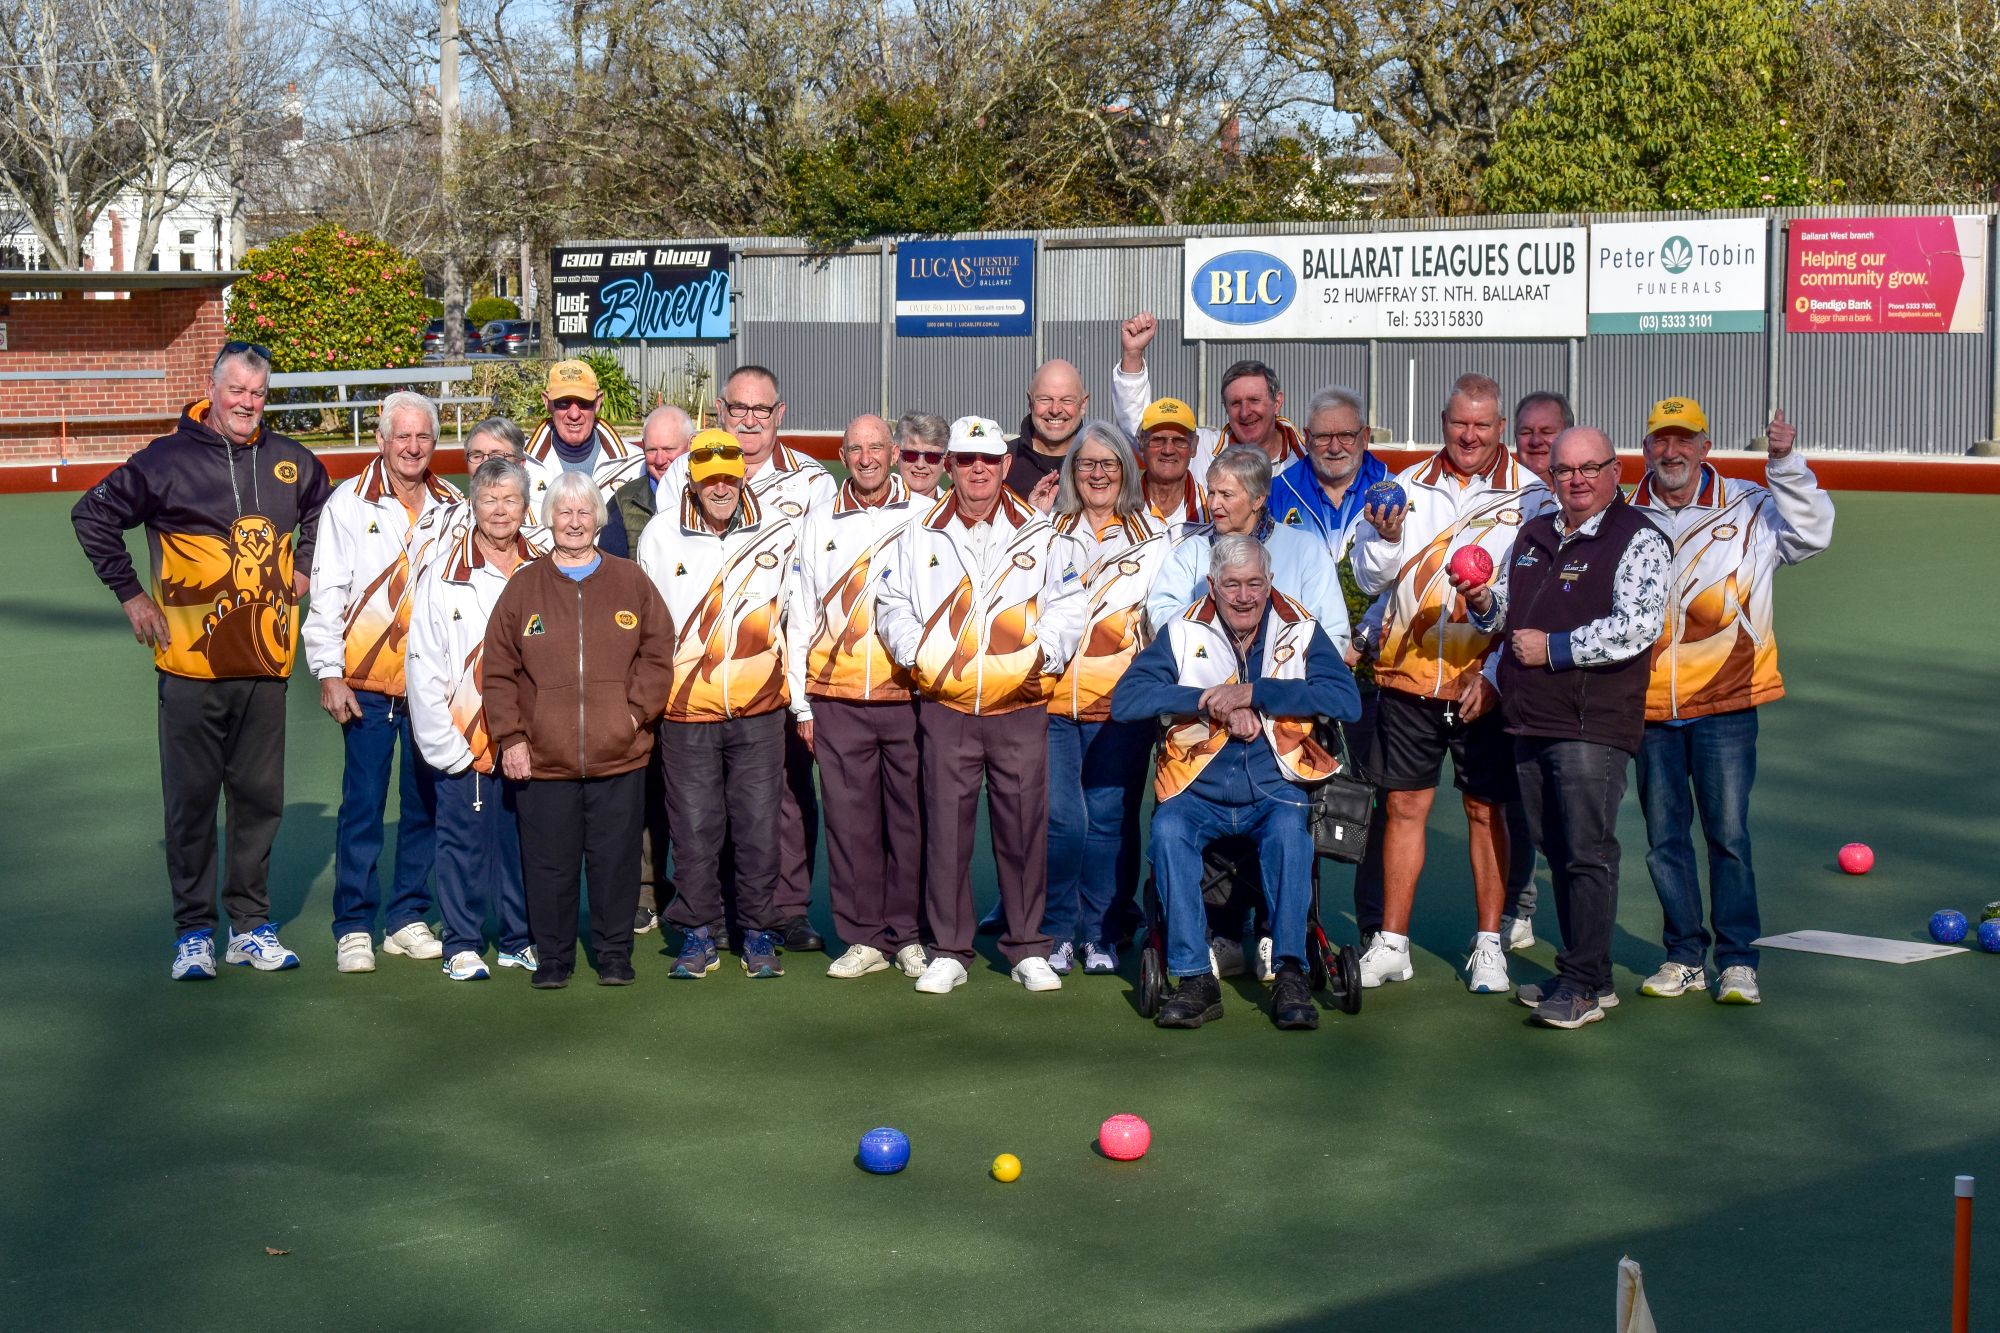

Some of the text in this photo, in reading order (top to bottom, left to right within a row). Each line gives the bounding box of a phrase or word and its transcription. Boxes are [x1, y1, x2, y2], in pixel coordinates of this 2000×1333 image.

[1801, 231, 1874, 240] Ballarat West branch
[561, 249, 711, 267] 1300 ask bluey
[974, 256, 1020, 266] LIFESTYLE
[1303, 242, 1575, 280] BALLARAT LEAGUES CLUB
[1600, 244, 1755, 269] Peter Tobin
[1801, 251, 1886, 269] Helping our
[910, 257, 976, 288] LUCAS
[980, 267, 1012, 276] ESTATE
[1800, 269, 1928, 289] community grow.
[1208, 268, 1283, 305] BLC
[1323, 284, 1550, 303] 52 HUMFFRAY ST. NTH. BALLARAT
[1637, 281, 1722, 295] FUNERALS
[556, 292, 590, 316] just
[594, 270, 730, 337] Bluey's
[910, 304, 929, 312] OVER
[946, 304, 972, 312] LIVING
[1810, 300, 1872, 311] Bendigo Bank
[559, 313, 588, 333] ask
[1387, 311, 1483, 327] Tel: 53315830
[1639, 314, 1712, 331] (03) 5333 3101
[1810, 314, 1831, 323] Bigger
[1832, 314, 1849, 322] than
